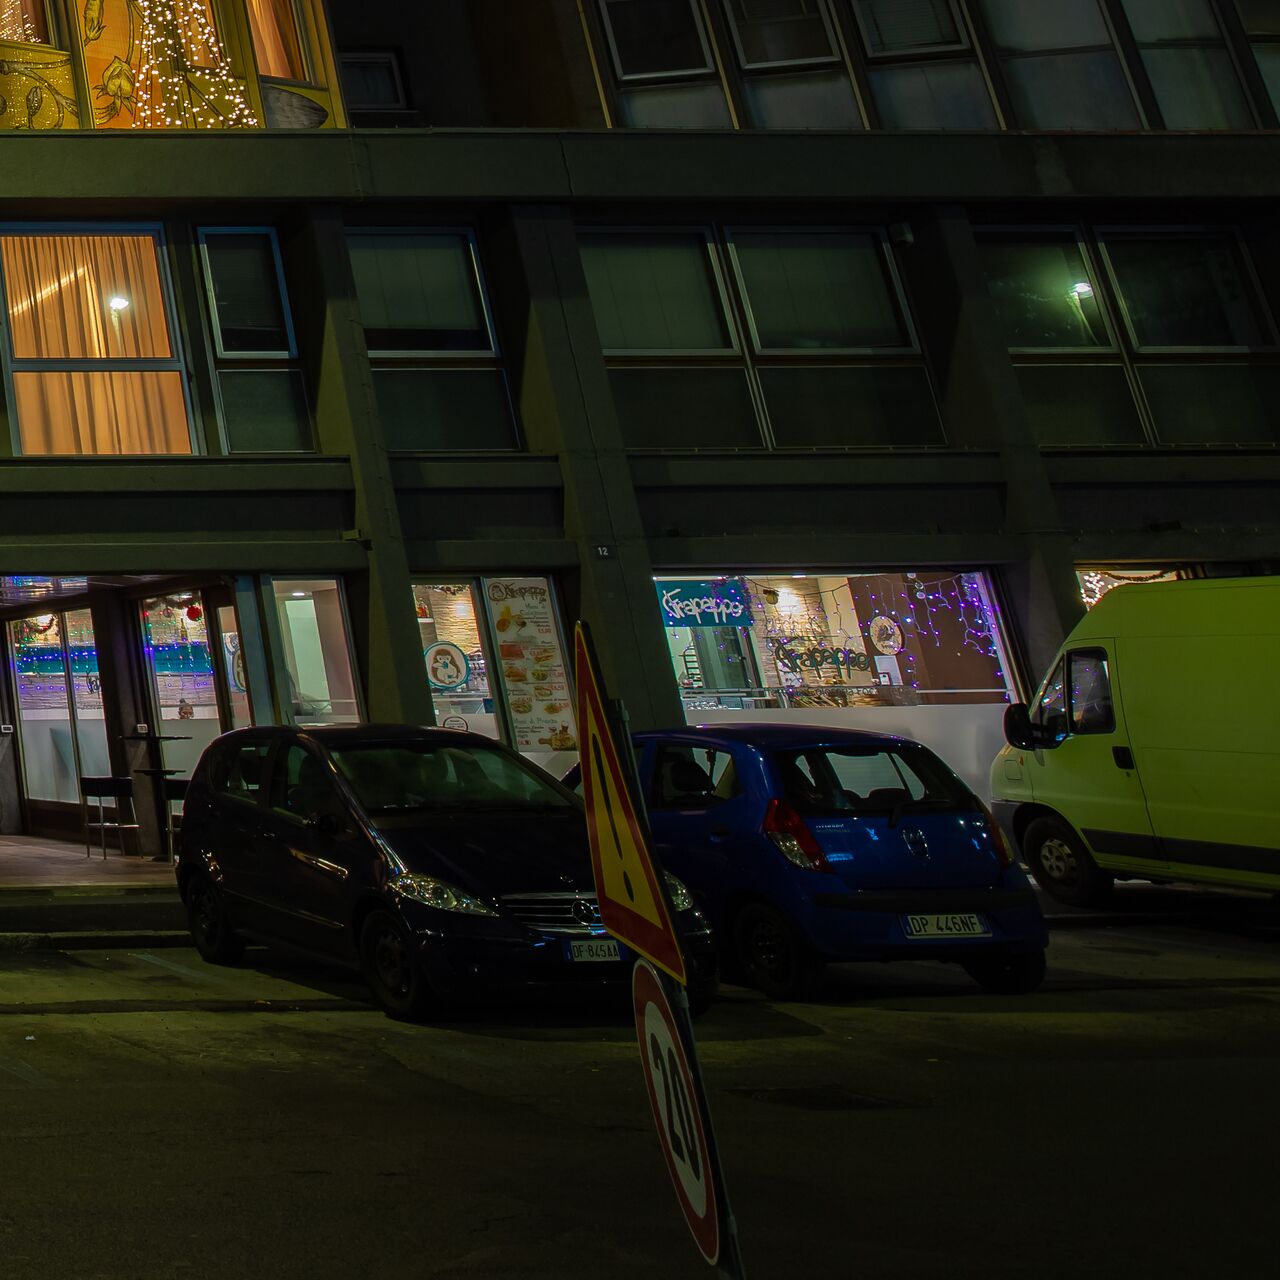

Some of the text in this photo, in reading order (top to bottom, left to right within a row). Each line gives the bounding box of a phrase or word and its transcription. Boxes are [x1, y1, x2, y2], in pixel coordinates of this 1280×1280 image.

[597, 546, 608, 556] 12
[911, 915, 978, 933] DP 446NF
[650, 1031, 701, 1183] 20
